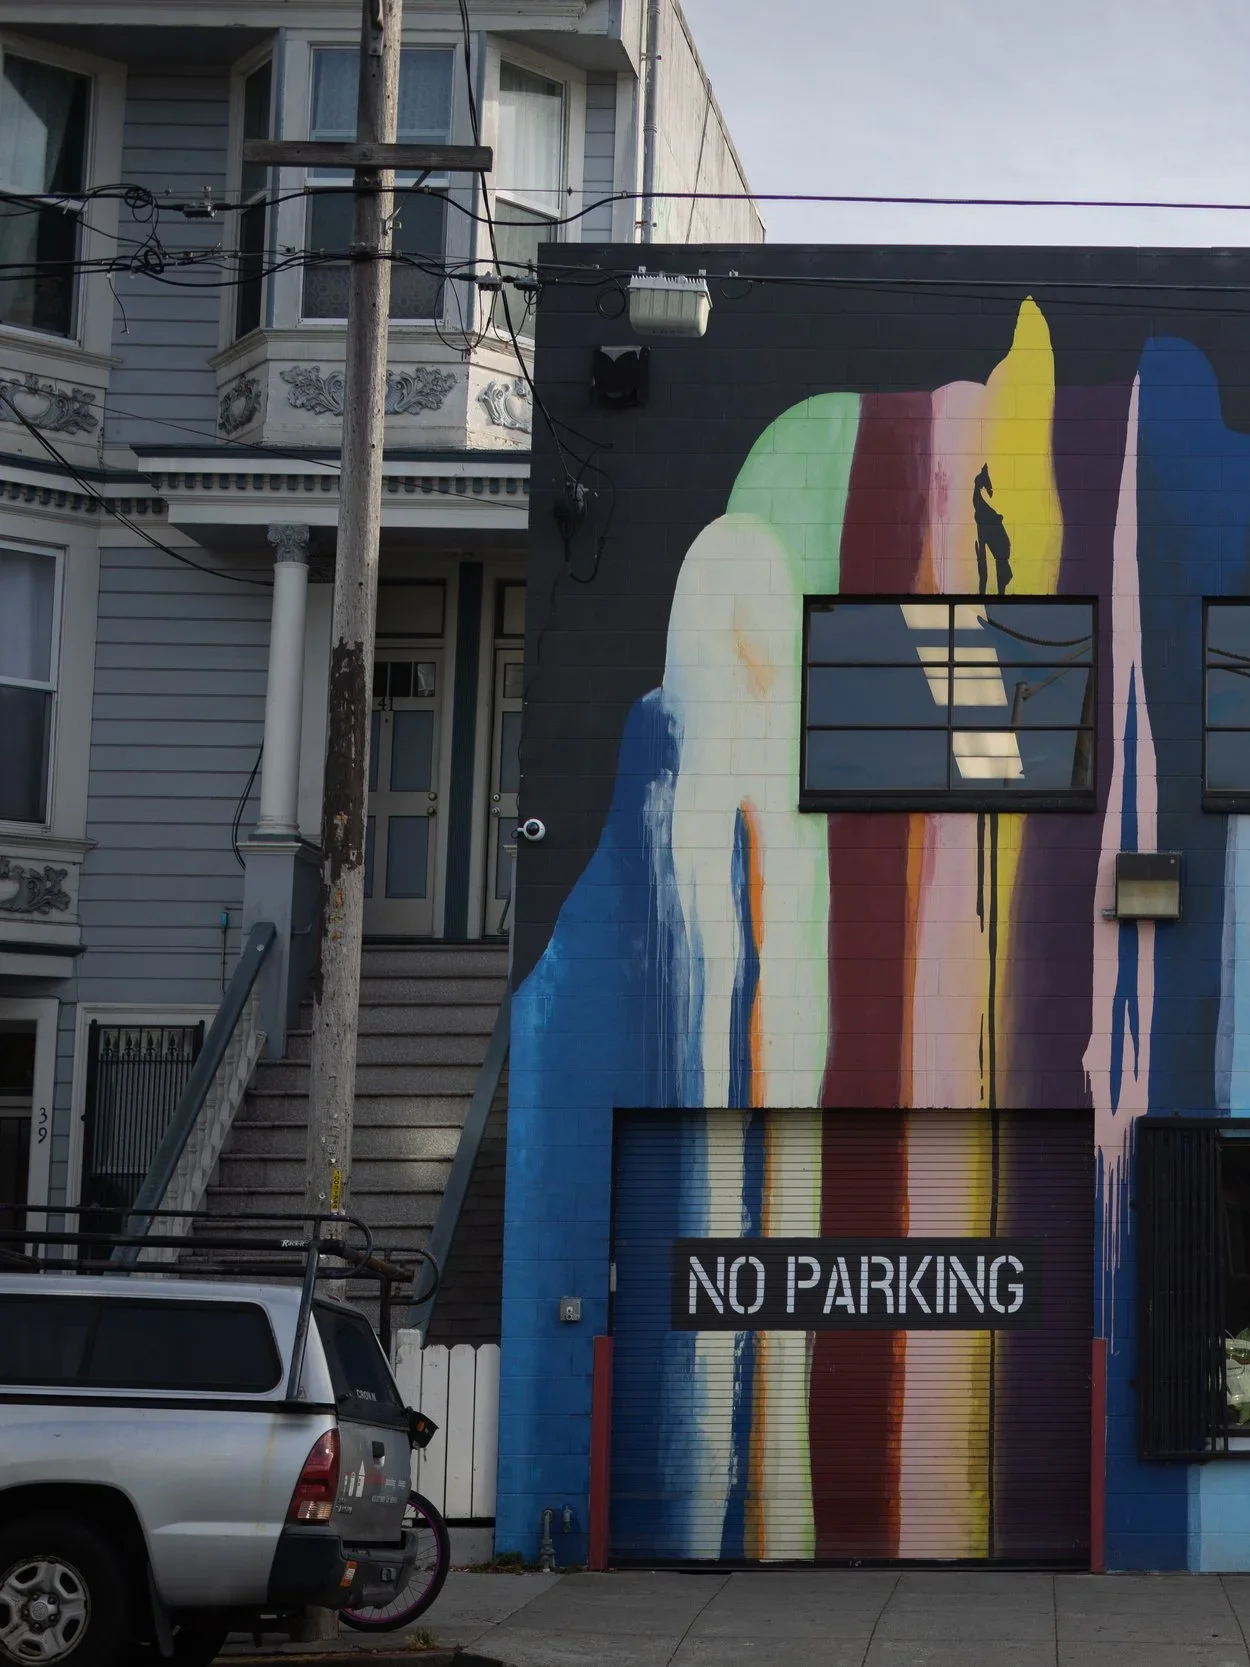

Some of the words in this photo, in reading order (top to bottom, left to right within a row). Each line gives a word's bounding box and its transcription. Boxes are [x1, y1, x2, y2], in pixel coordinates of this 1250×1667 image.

[377, 697, 393, 712] 41
[38, 1107, 48, 1144] 39
[688, 1256, 765, 1314] NO
[786, 1255, 1024, 1314] PARKING
